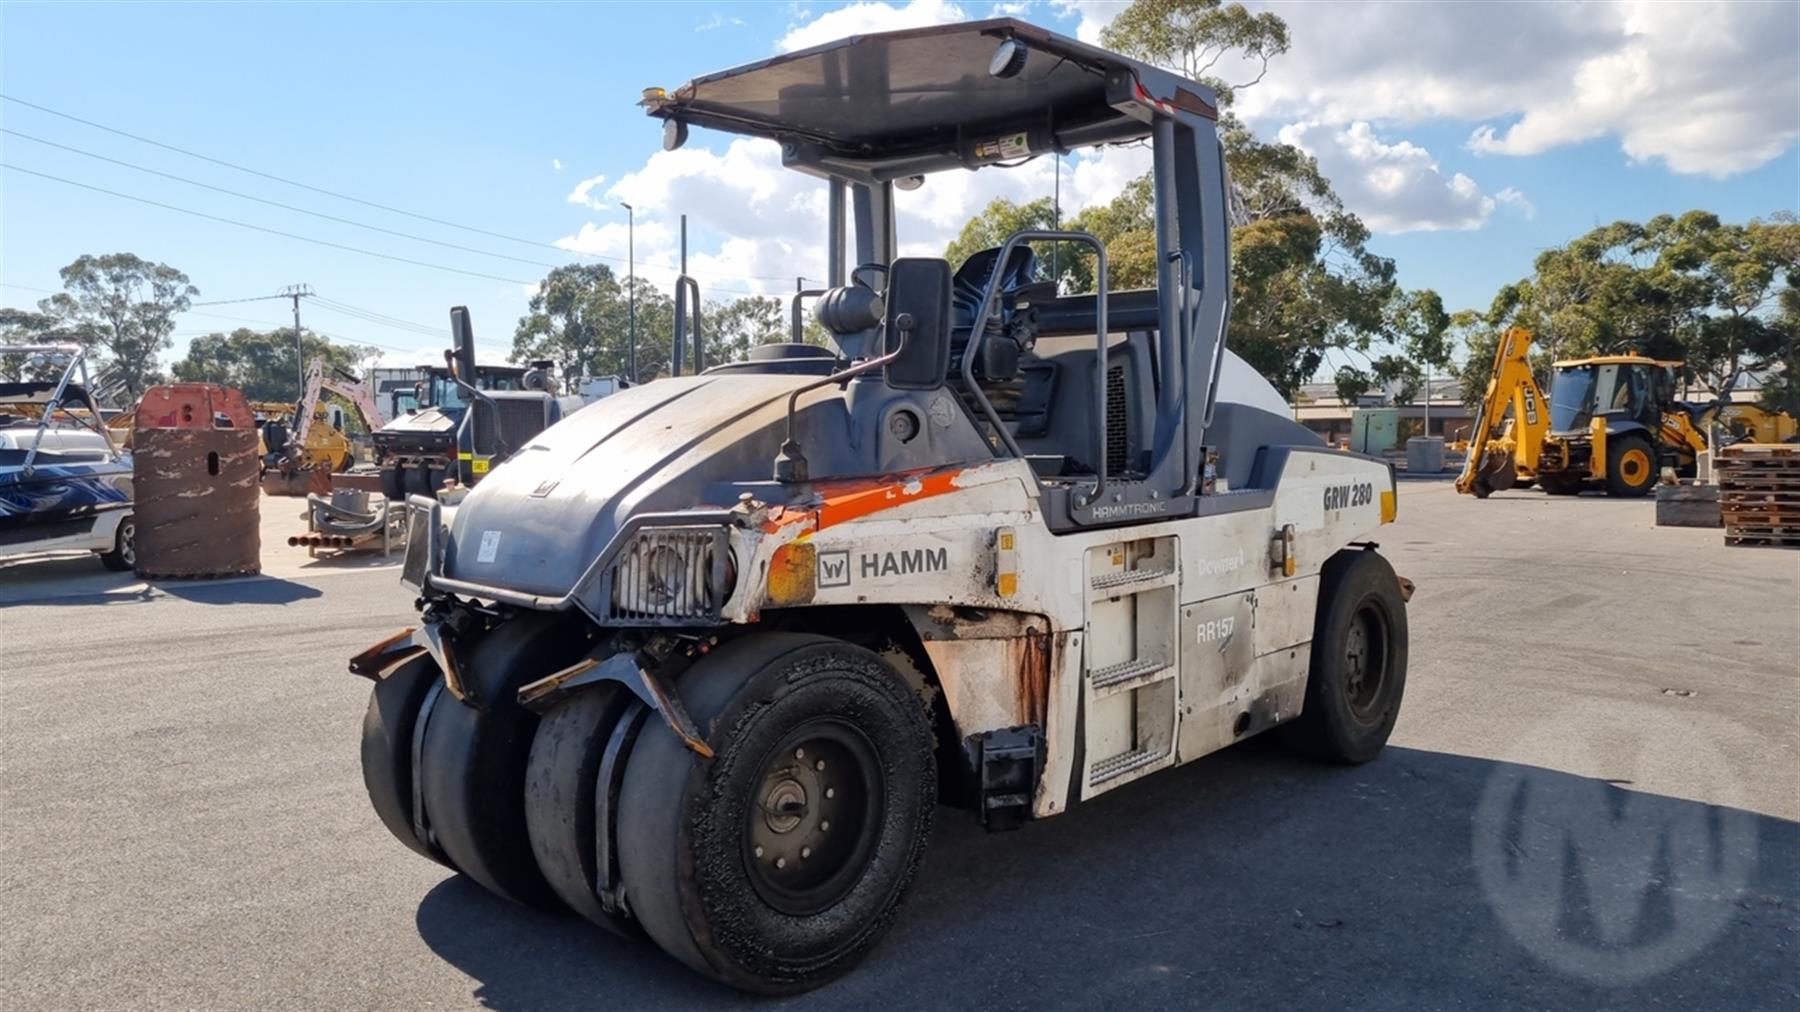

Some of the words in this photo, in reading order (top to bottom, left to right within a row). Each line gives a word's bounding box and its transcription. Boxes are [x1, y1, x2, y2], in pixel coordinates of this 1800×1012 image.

[1523, 386, 1537, 424] JCB
[1092, 501, 1167, 519] HAMMTRONIC
[1324, 485, 1350, 511] GRW
[1352, 483, 1372, 507] 280
[861, 547, 947, 578] HAMM
[1197, 616, 1235, 644] RR157
